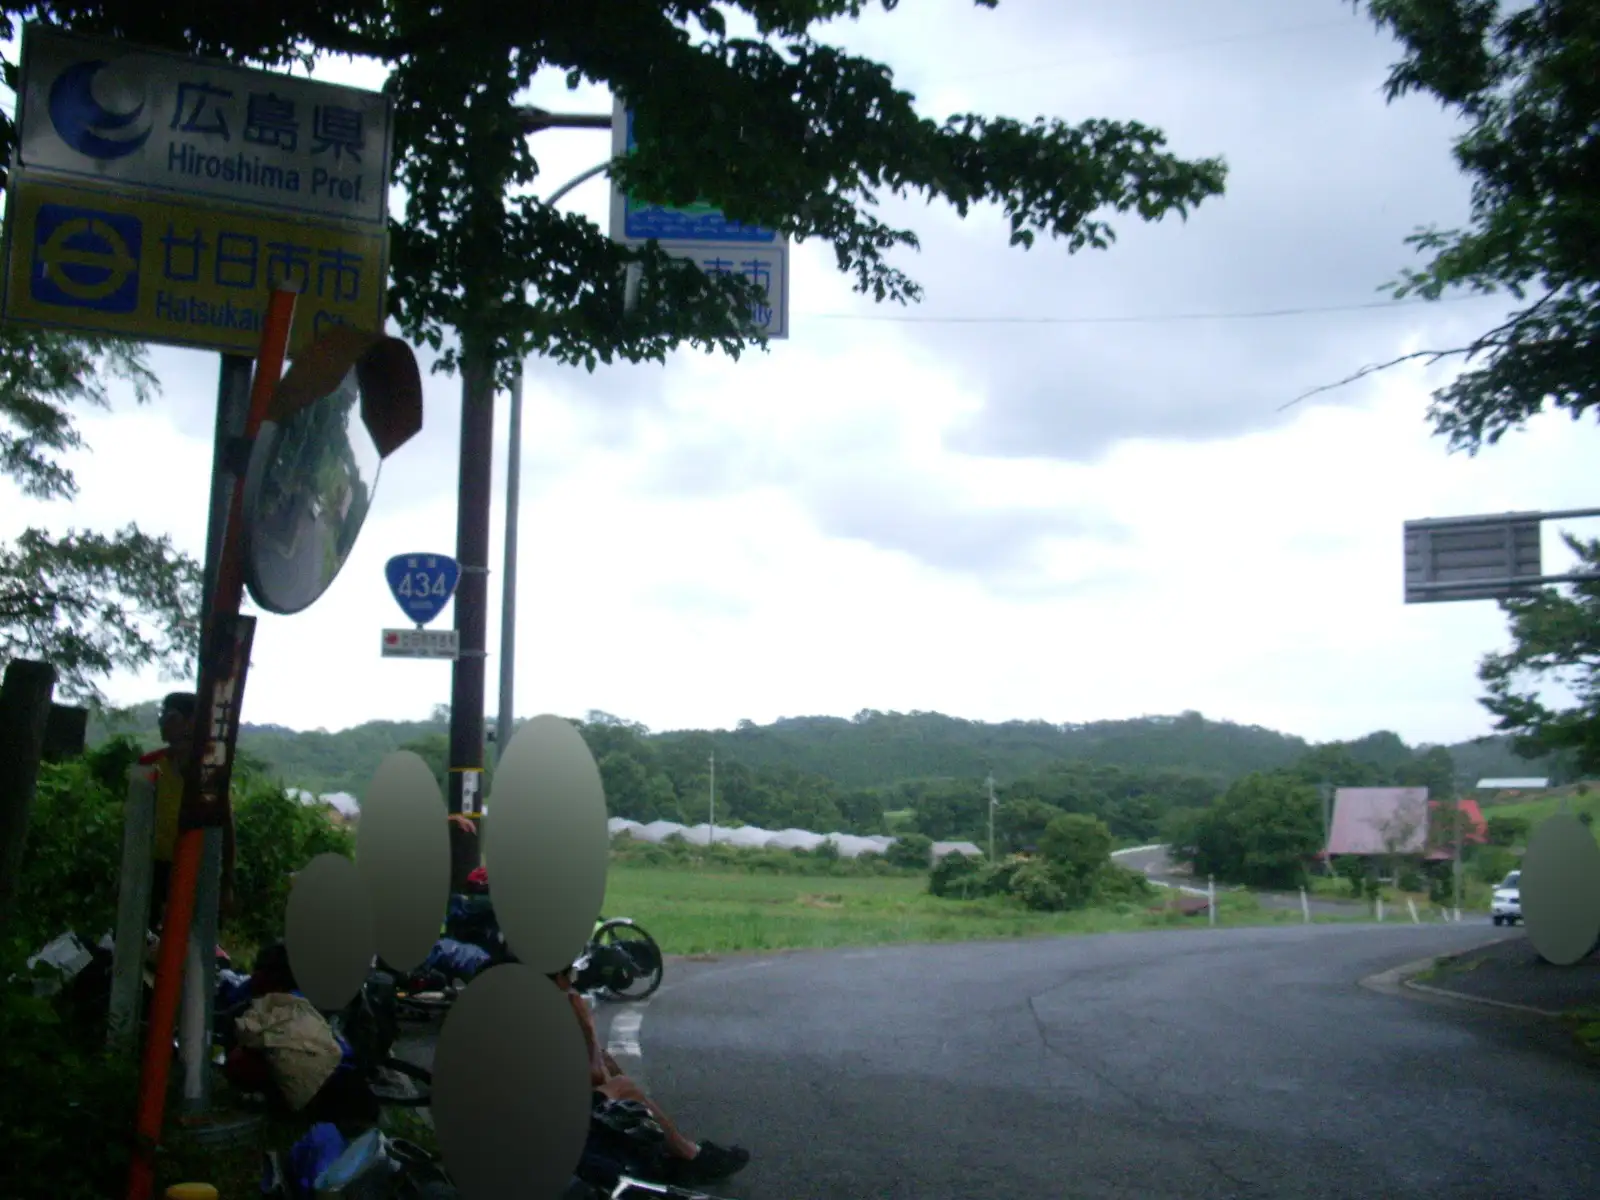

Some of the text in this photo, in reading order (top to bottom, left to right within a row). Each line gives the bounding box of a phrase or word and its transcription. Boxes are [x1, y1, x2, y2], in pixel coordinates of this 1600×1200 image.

[170, 81, 366, 163] 広島県
[168, 142, 365, 203] Hiroshima Pref.
[160, 223, 363, 302] 廿日市市
[156, 291, 265, 332] Hatsukai
[397, 571, 447, 598] 434
